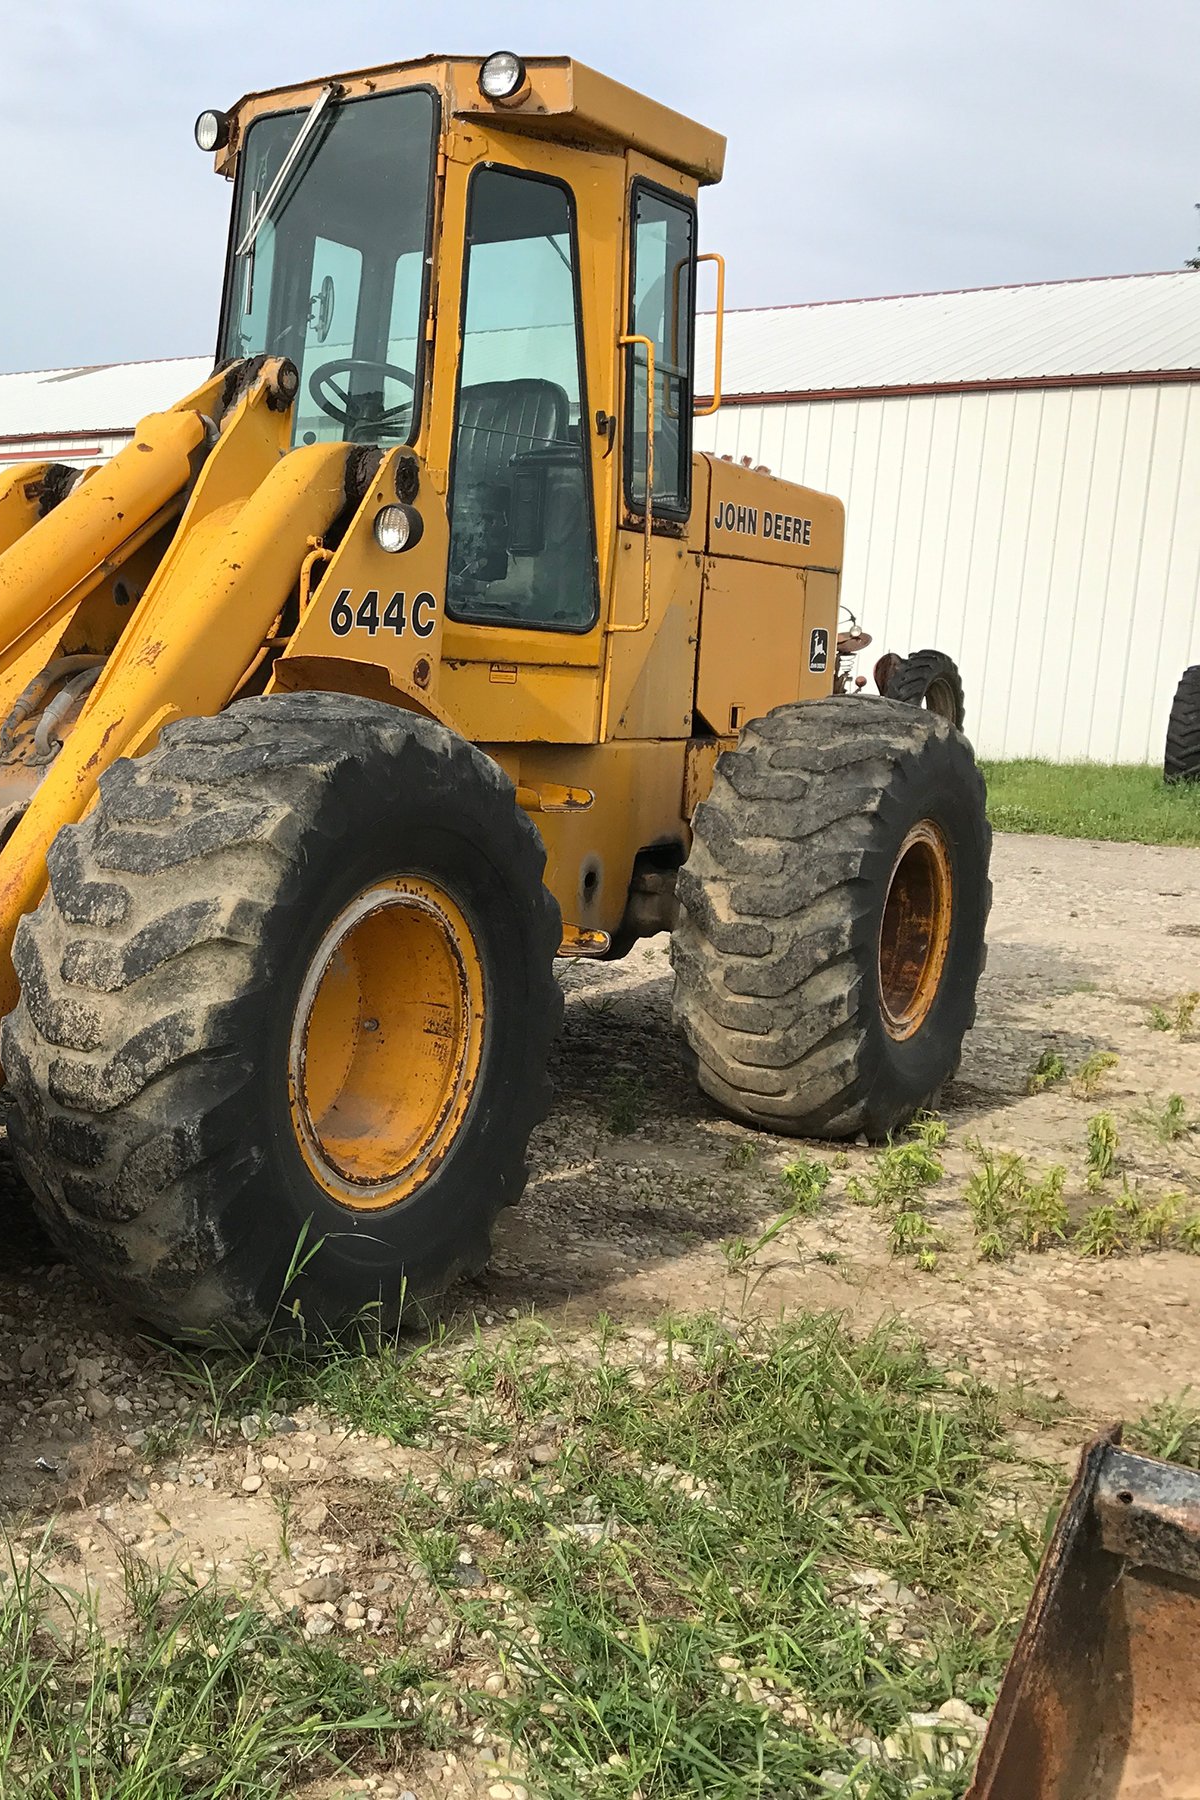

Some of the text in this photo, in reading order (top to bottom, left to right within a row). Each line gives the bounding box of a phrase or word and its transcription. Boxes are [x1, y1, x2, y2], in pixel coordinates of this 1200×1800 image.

[714, 501, 811, 546] JOHN DEERE
[329, 588, 437, 638] 644C
